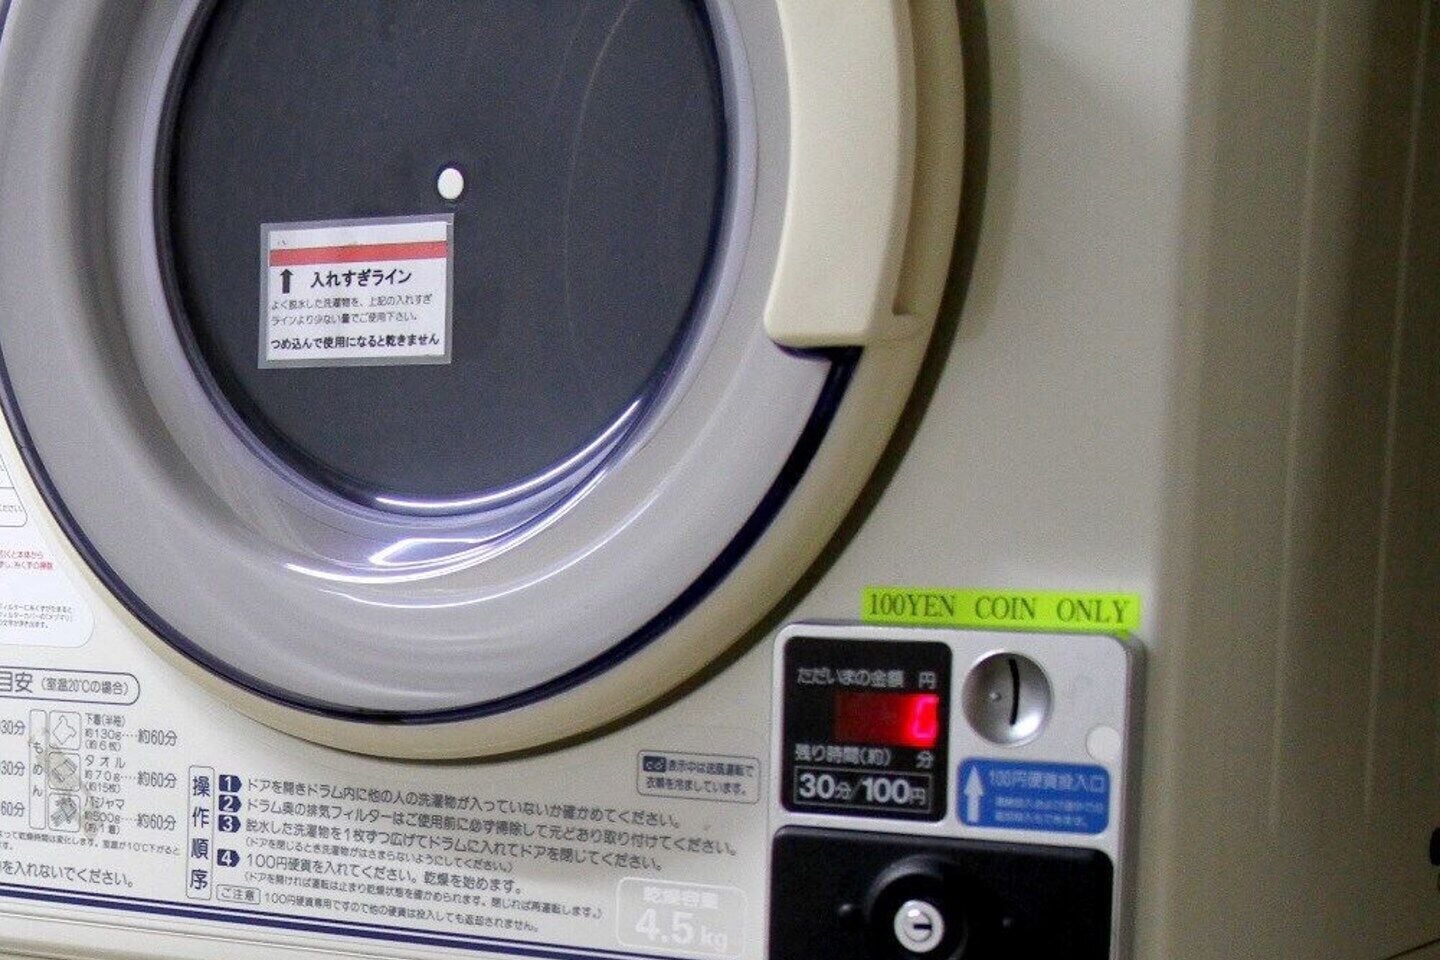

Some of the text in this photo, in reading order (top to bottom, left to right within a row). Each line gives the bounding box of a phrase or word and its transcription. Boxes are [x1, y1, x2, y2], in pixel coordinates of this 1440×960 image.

[310, 268, 412, 288] 入れすぎライン
[271, 294, 433, 311] よく脱水した洗濯物を、上記の入れすぎ
[870, 594, 1131, 624] 100YEN COIN ONLY
[798, 667, 936, 689] ただいまの金額 円
[85, 754, 126, 769] タオル
[916, 750, 934, 768] 分
[189, 775, 210, 891] 操作順序
[220, 886, 255, 902] ご注意
[635, 908, 728, 952] 4.5kg
